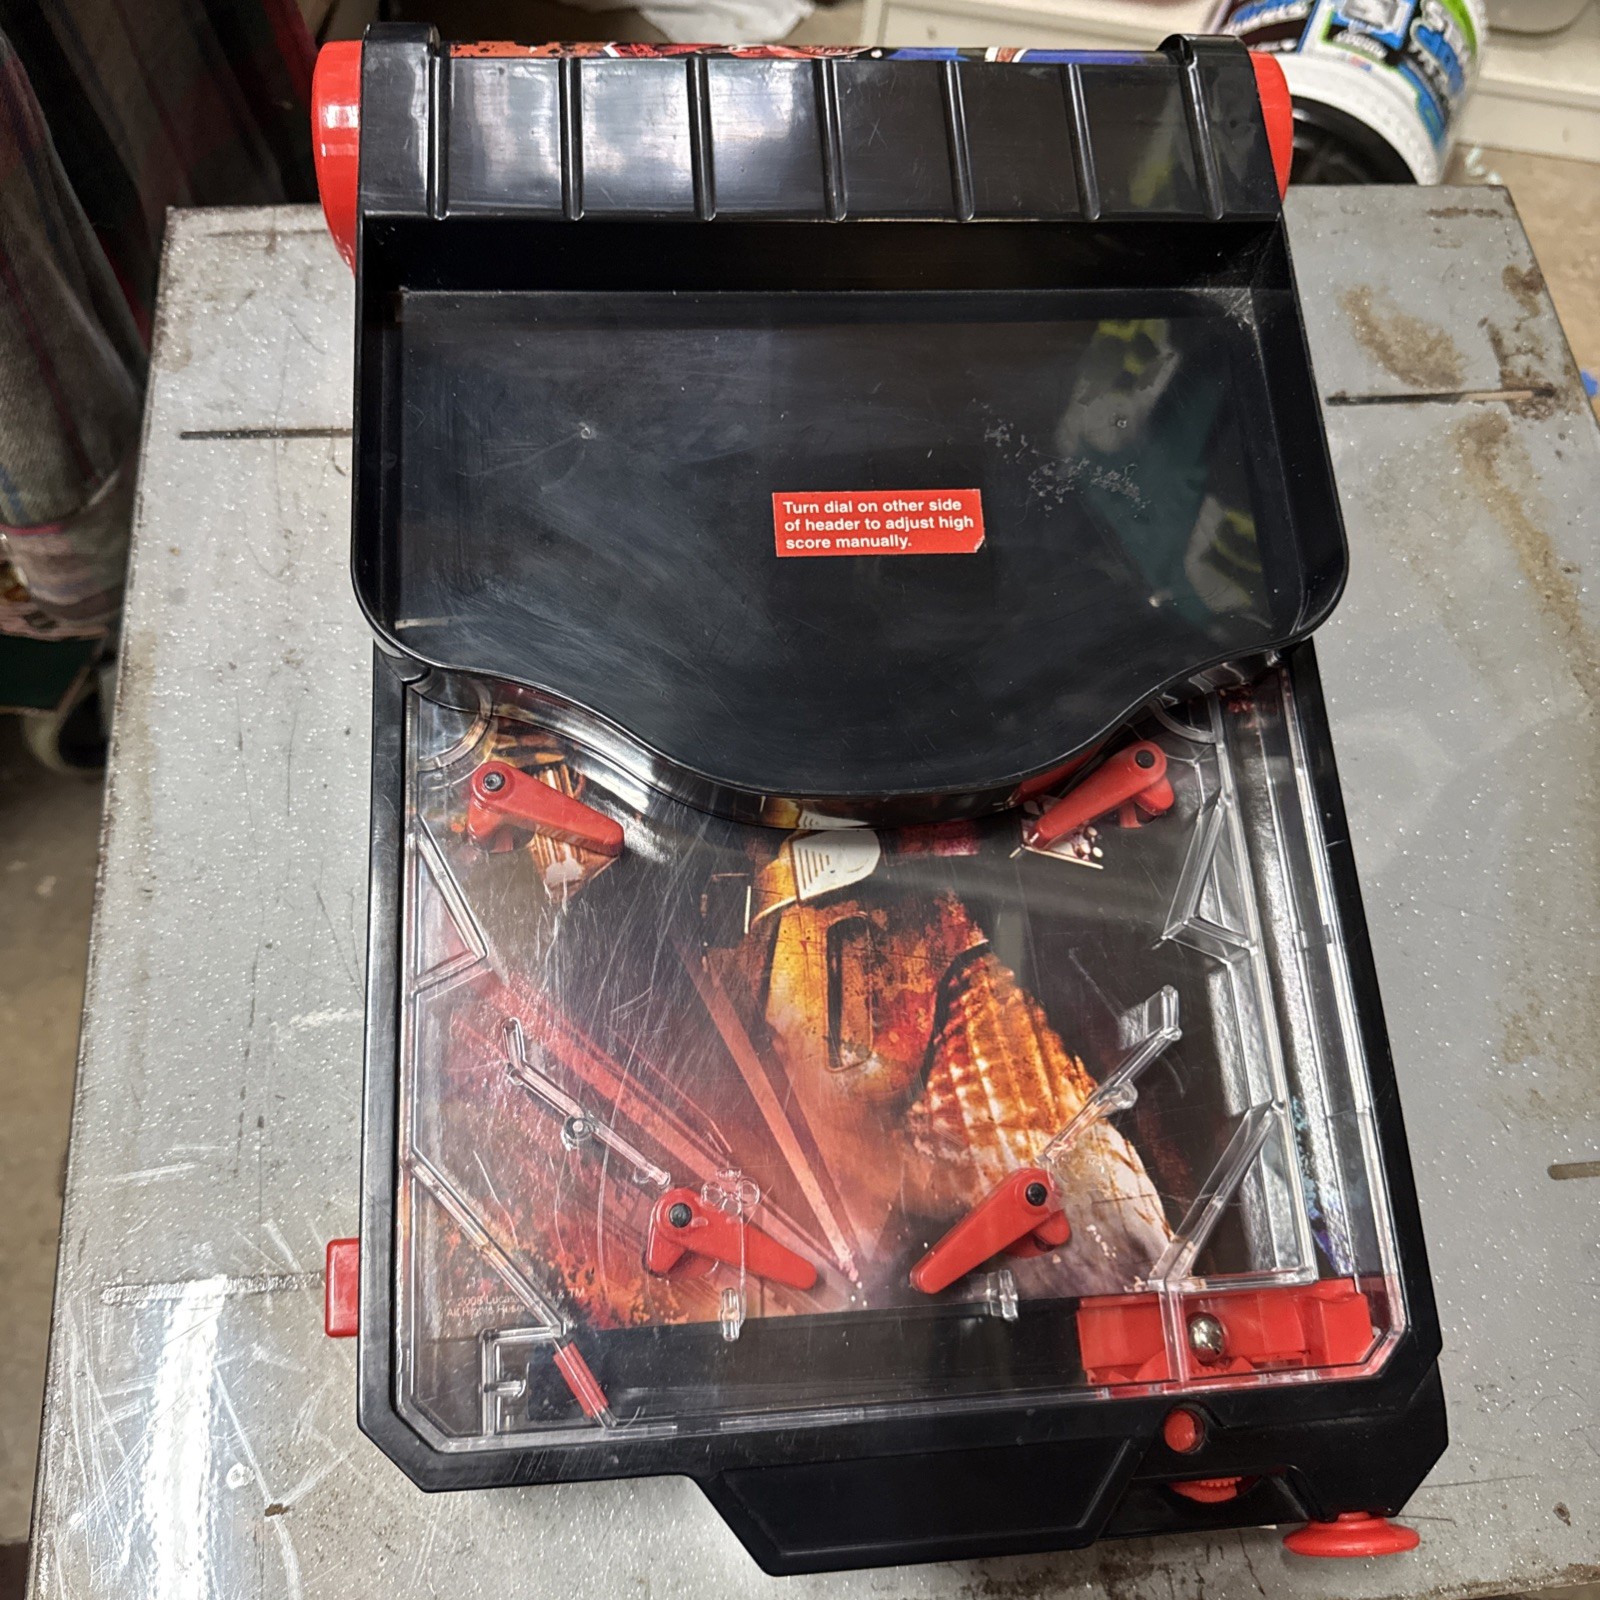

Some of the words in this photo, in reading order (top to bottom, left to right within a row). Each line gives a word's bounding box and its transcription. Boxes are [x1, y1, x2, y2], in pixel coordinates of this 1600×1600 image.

[783, 501, 820, 514] Turn
[824, 500, 853, 513] dial
[857, 502, 878, 513] on
[882, 499, 925, 512] other
[929, 498, 962, 511] side
[784, 519, 801, 531] of
[805, 518, 860, 531] header
[865, 518, 881, 530] to
[885, 516, 935, 532] adjust
[938, 515, 974, 531] high
[785, 538, 831, 549] score
[836, 534, 912, 550] manually.
